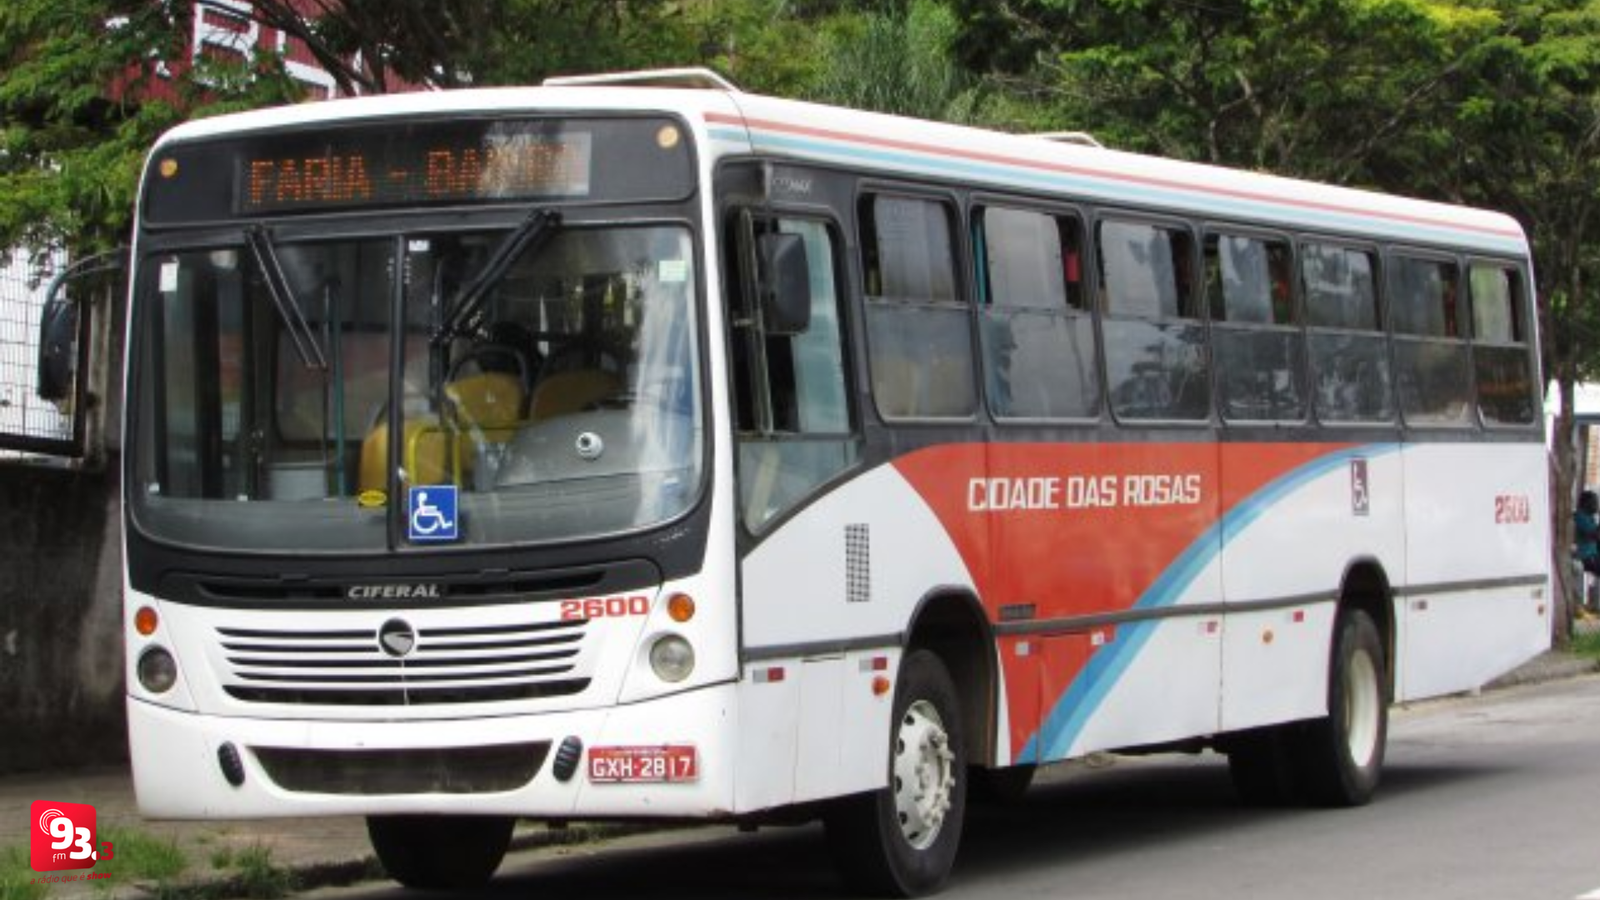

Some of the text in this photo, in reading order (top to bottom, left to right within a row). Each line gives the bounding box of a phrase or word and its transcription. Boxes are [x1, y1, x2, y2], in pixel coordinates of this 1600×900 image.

[250, 155, 371, 205] FARIA
[967, 474, 1201, 511] CIDADE DAS ROSAS
[348, 584, 441, 598] CIFERAL
[560, 596, 649, 621] 2600
